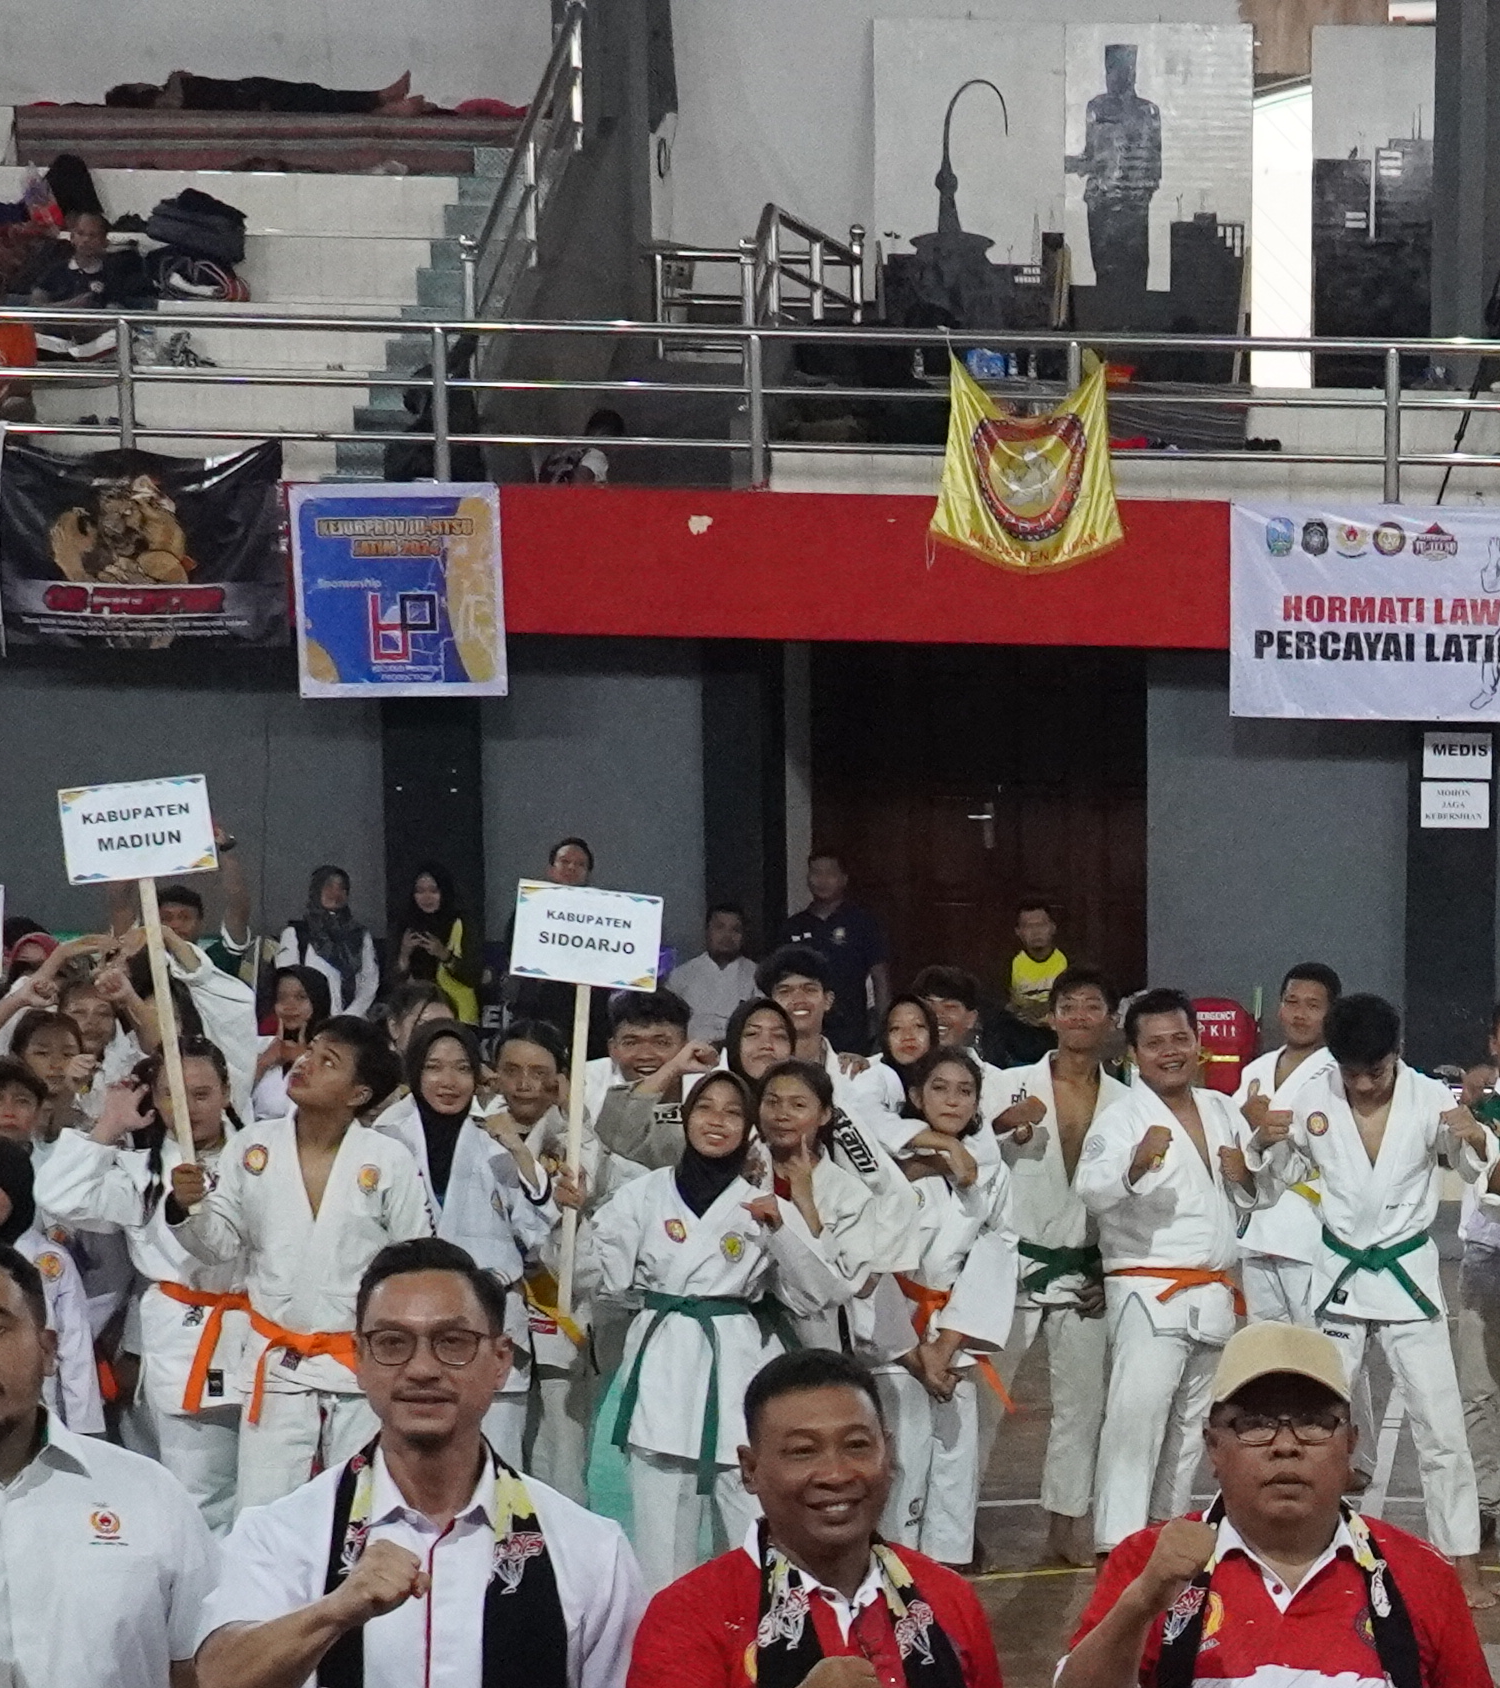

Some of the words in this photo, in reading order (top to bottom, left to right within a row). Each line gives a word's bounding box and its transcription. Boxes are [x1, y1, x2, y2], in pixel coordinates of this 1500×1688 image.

[1282, 594, 1425, 624] HORMATI
[1253, 629, 1416, 663] PERCAYAI
[1432, 743, 1489, 757] MEDIS
[81, 801, 190, 826] KABUPATEN
[97, 829, 183, 852] MADIUN
[546, 908, 633, 930] KABUPATEN
[538, 930, 636, 955] SIDOARJO
